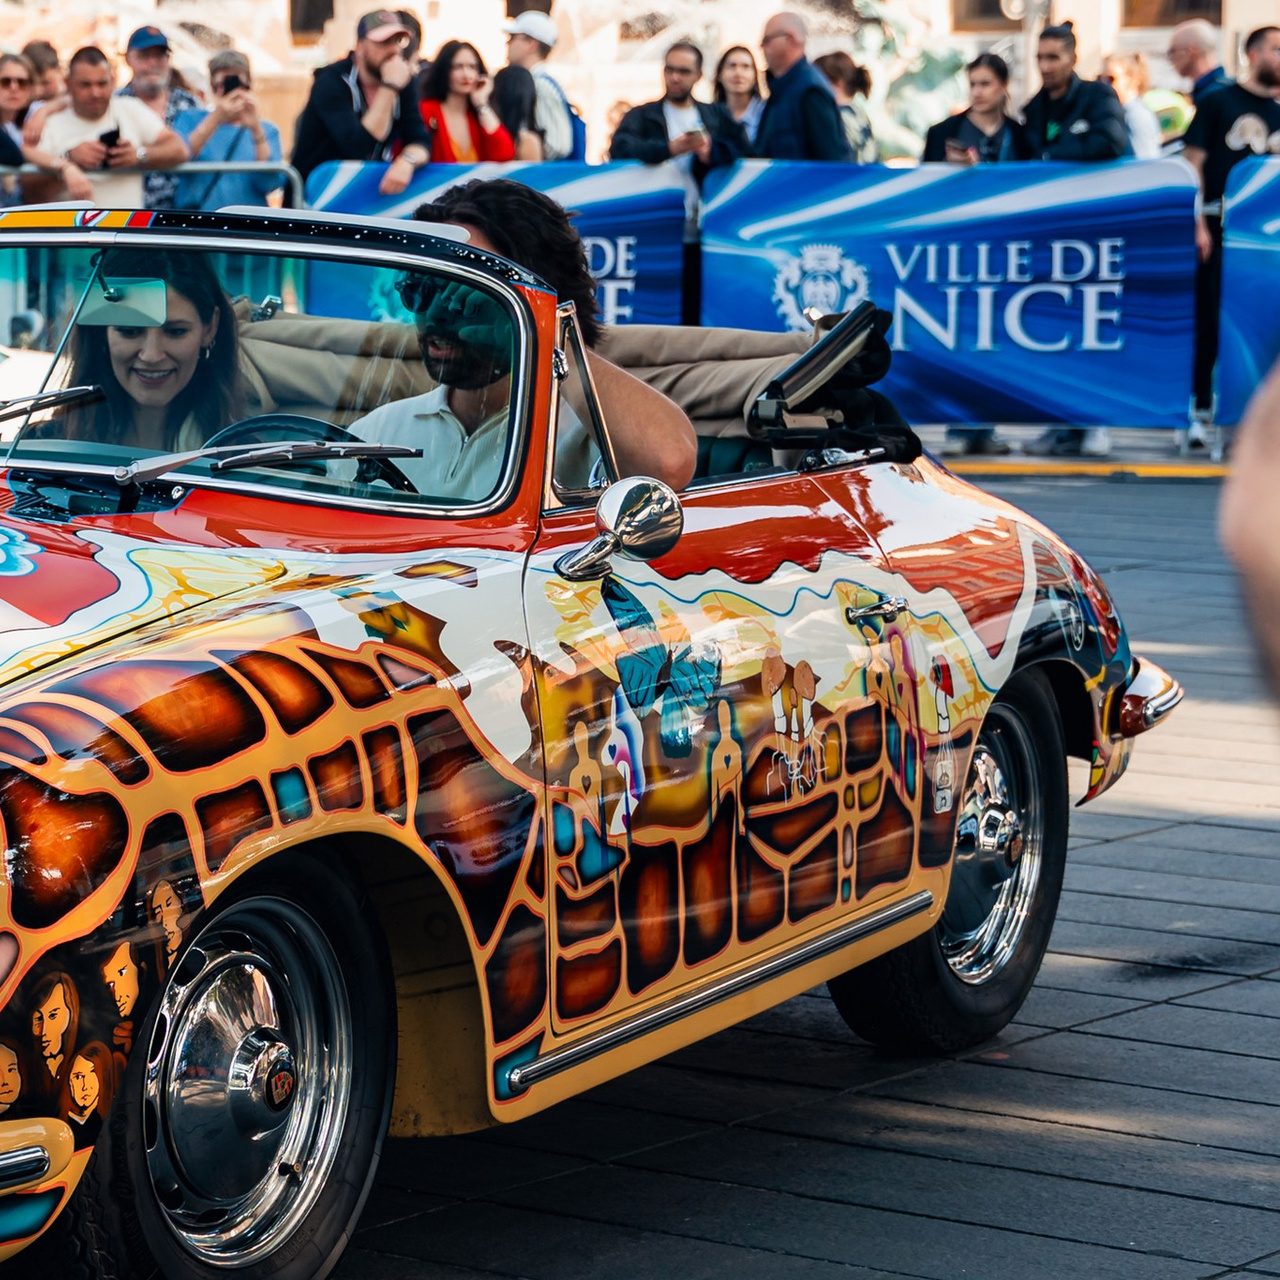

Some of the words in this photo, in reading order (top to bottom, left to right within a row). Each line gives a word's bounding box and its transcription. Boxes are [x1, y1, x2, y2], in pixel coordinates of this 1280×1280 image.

[883, 240, 1034, 283] VILLE
[1049, 237, 1126, 283] DE
[891, 282, 1125, 352] NICE
